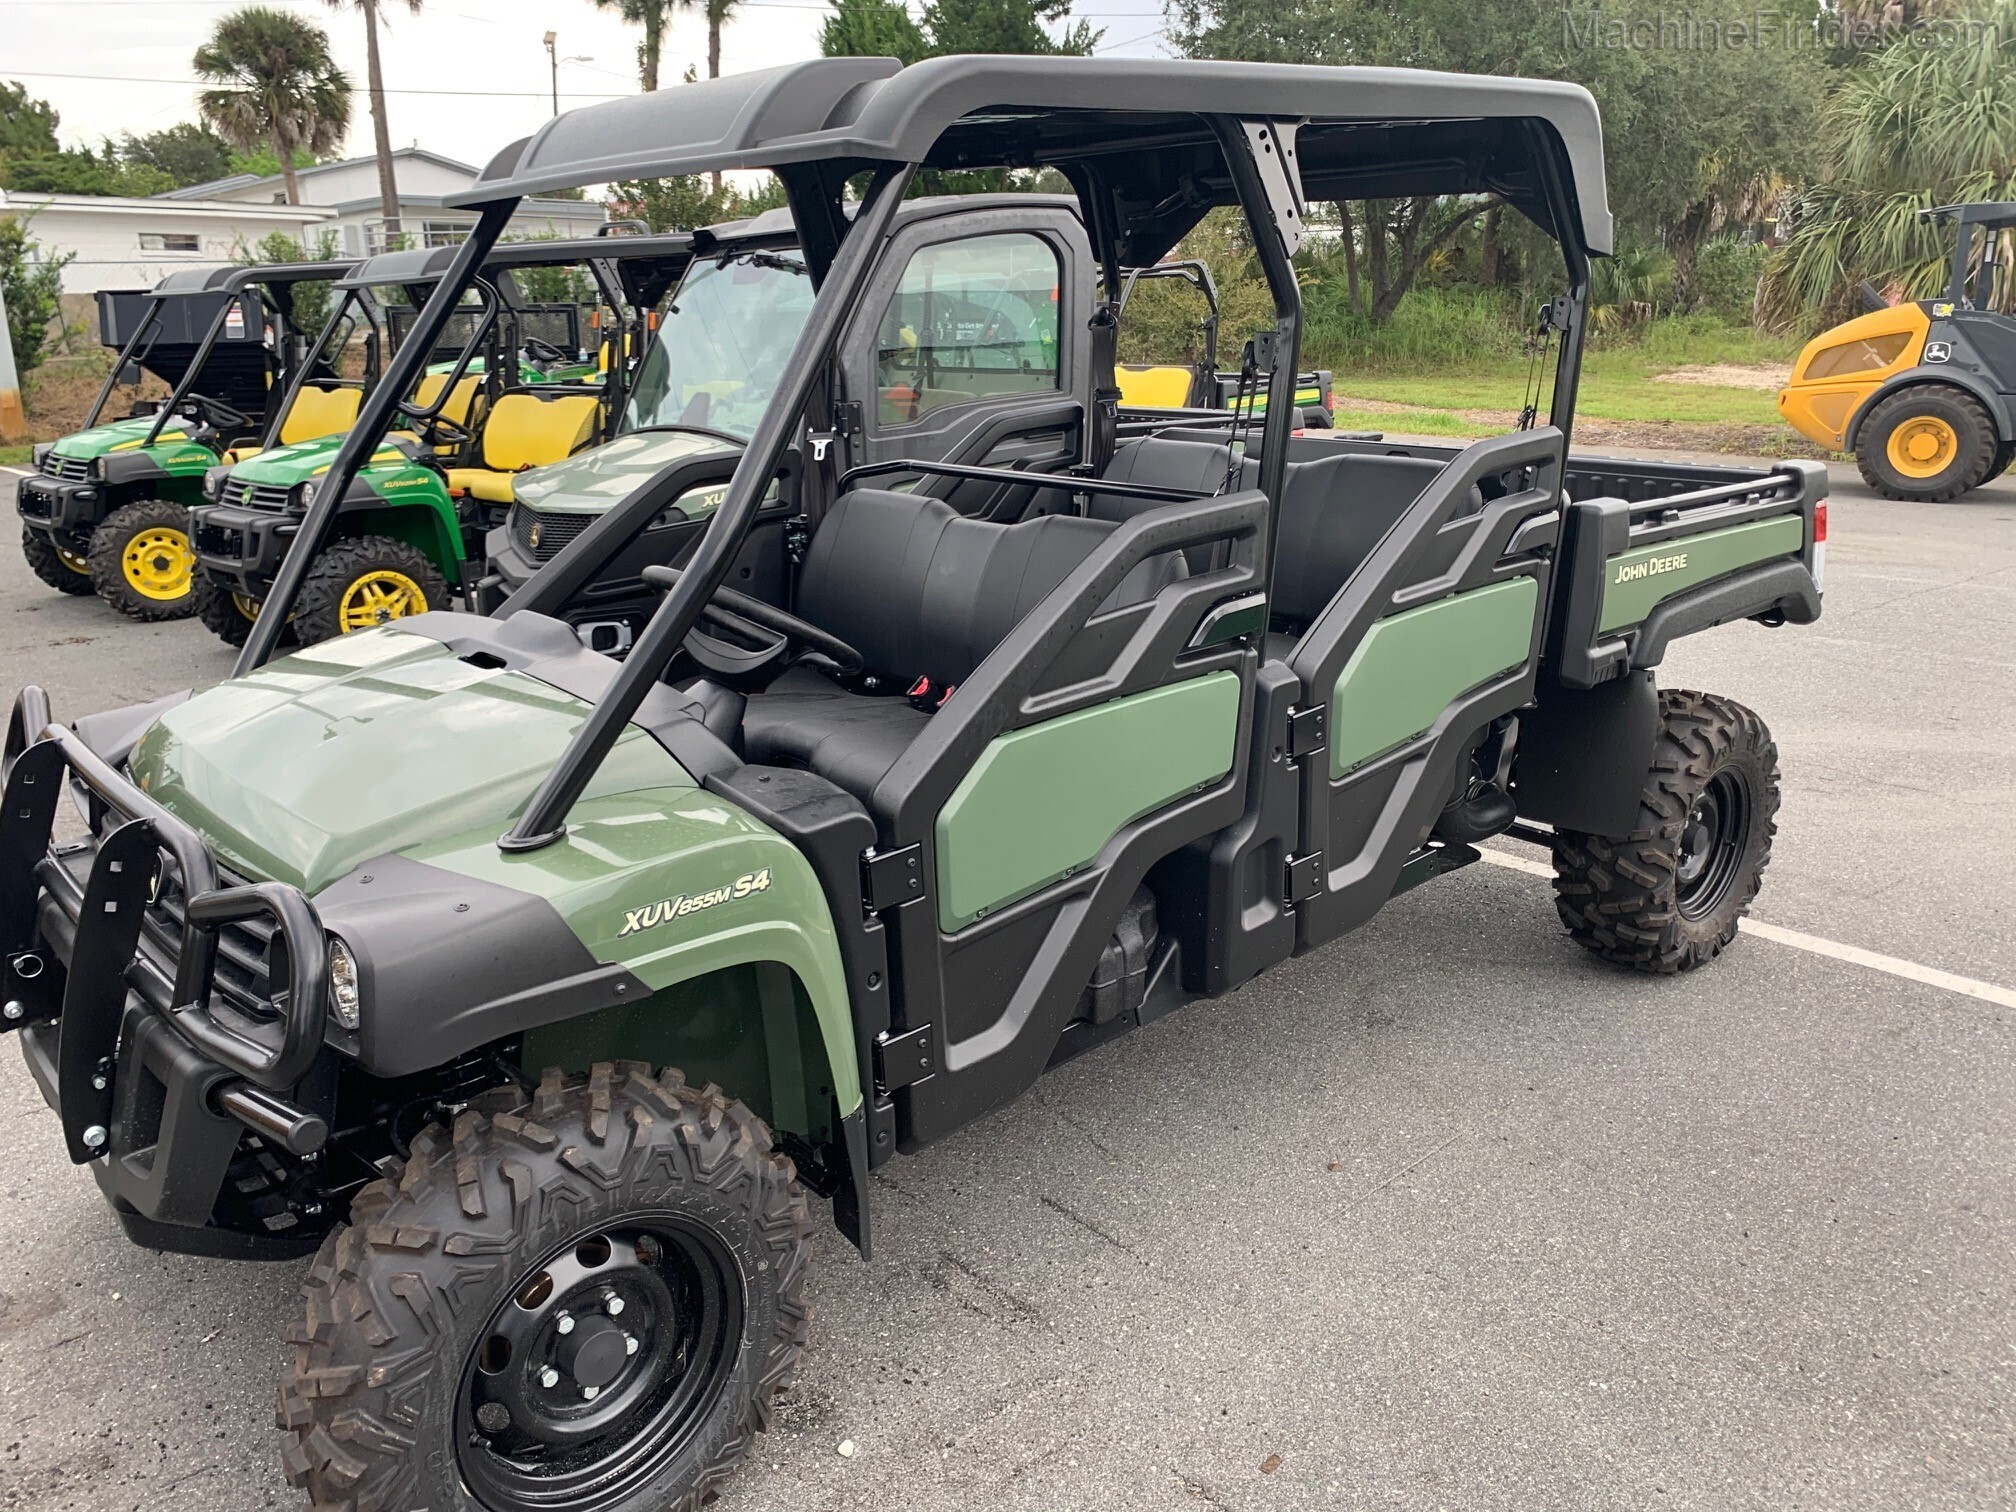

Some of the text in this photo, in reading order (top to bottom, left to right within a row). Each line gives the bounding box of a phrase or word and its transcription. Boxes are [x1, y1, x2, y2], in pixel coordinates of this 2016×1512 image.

[416, 477, 429, 485] S4
[1614, 553, 1688, 585] JOHN DEERE
[618, 868, 771, 936] XUV855M S4
